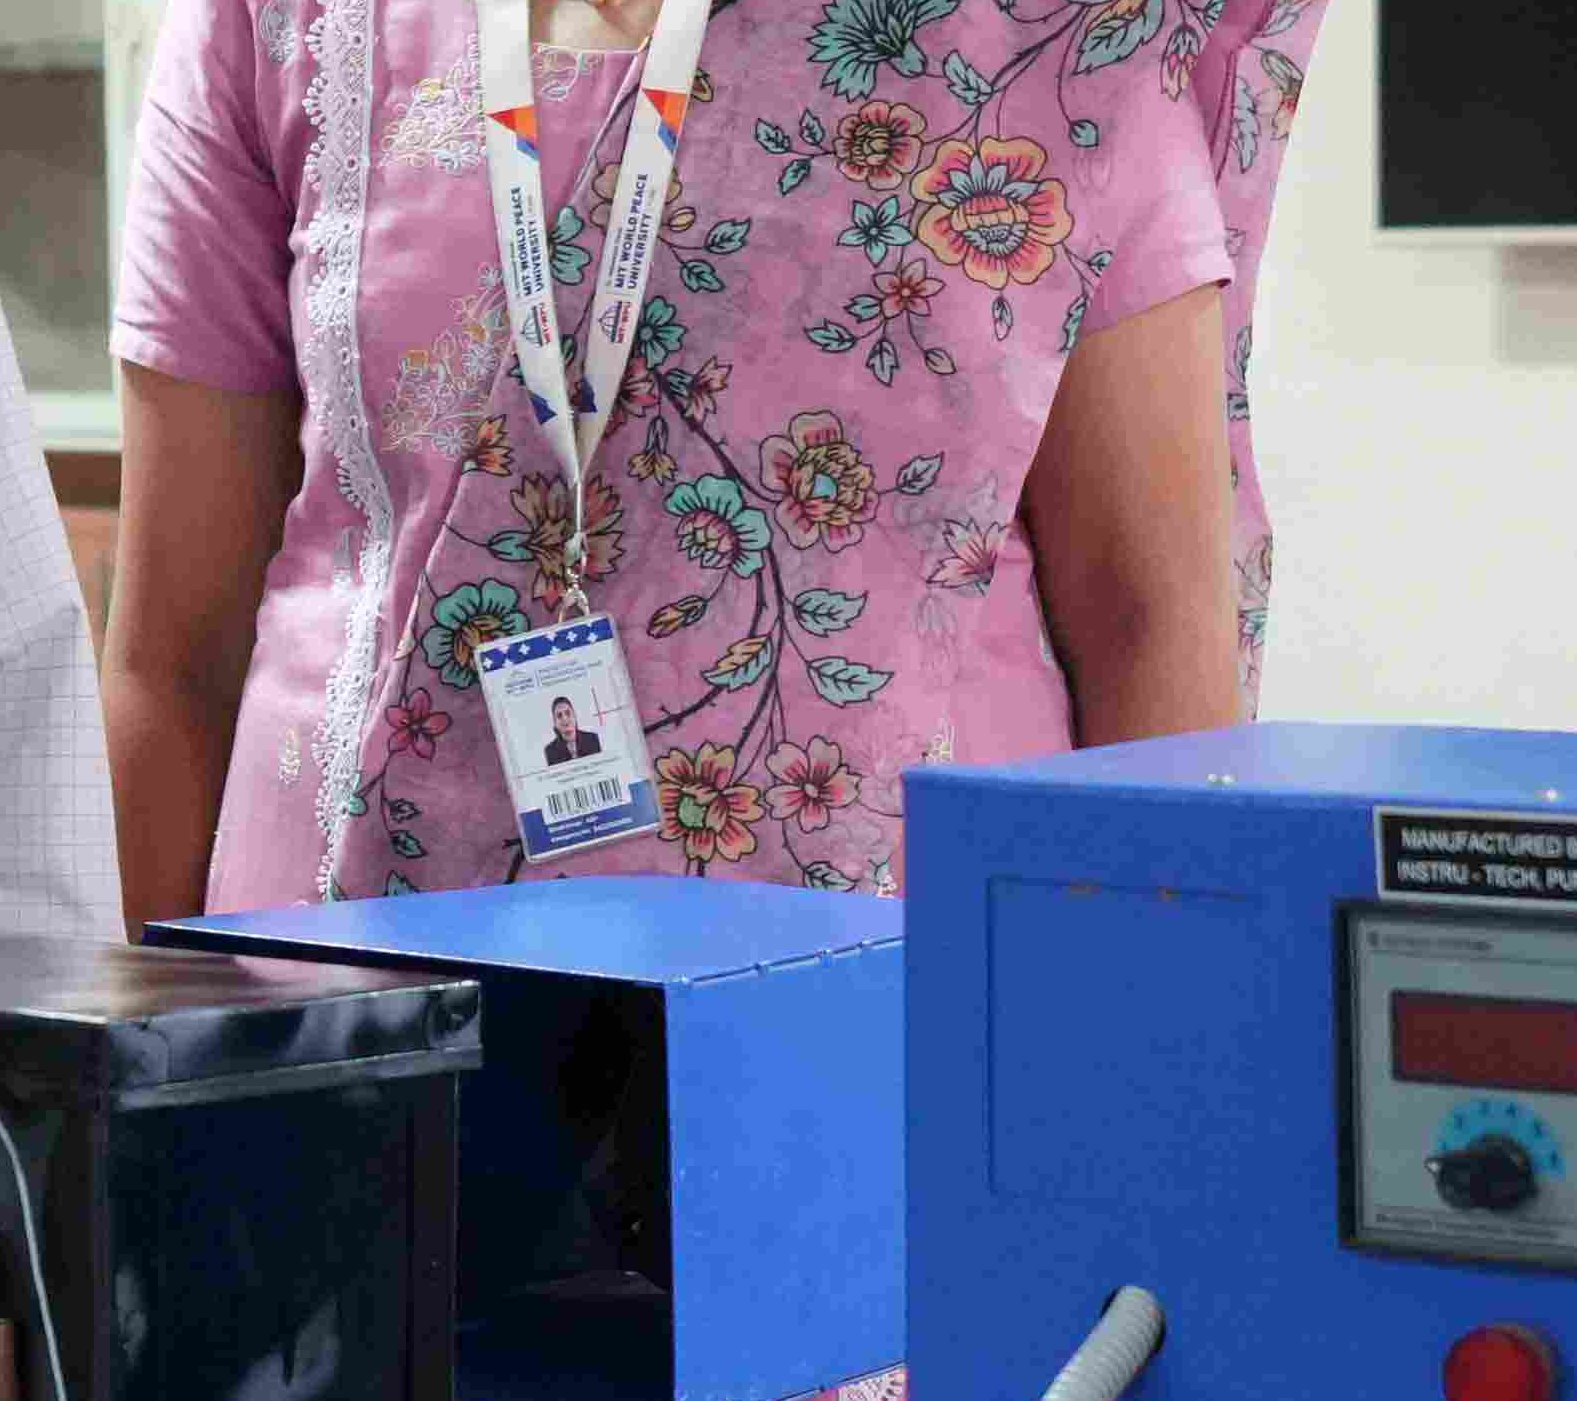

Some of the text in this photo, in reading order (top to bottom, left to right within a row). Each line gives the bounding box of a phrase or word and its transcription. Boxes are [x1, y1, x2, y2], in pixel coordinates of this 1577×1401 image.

[510, 187, 524, 226] PEACE
[515, 228, 530, 271] WORLD
[614, 173, 649, 289] MIT WORLD PEACE
[627, 213, 653, 290] UNIVERSITY
[528, 221, 545, 293] UNIVERSITY
[521, 272, 533, 296] MIT
[1400, 826, 1564, 858] MANUFACTURED
[1397, 860, 1470, 886] INSTRU
